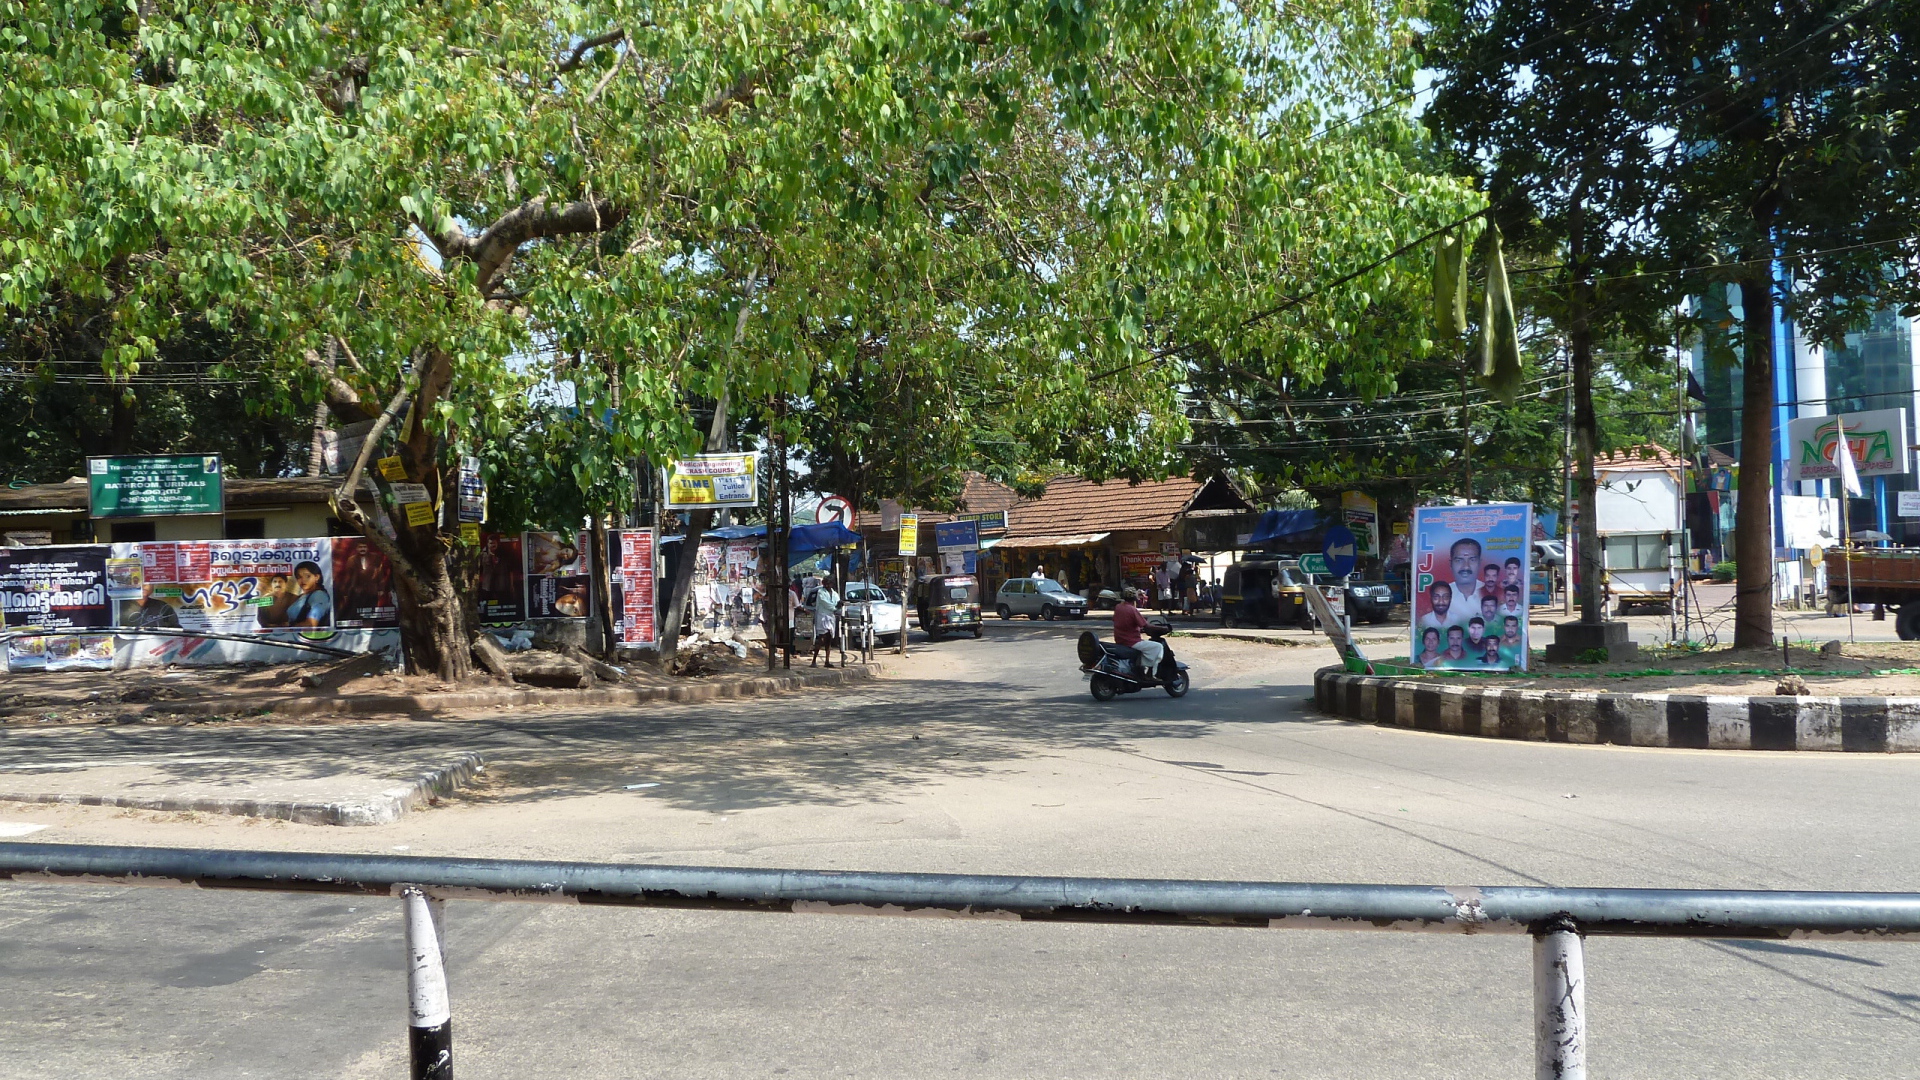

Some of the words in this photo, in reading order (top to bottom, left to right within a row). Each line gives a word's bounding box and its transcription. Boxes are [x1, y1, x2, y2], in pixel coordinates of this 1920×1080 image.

[121, 474, 189, 482] TOILET
[680, 479, 710, 488] TIME
[981, 512, 1003, 521] STORE
